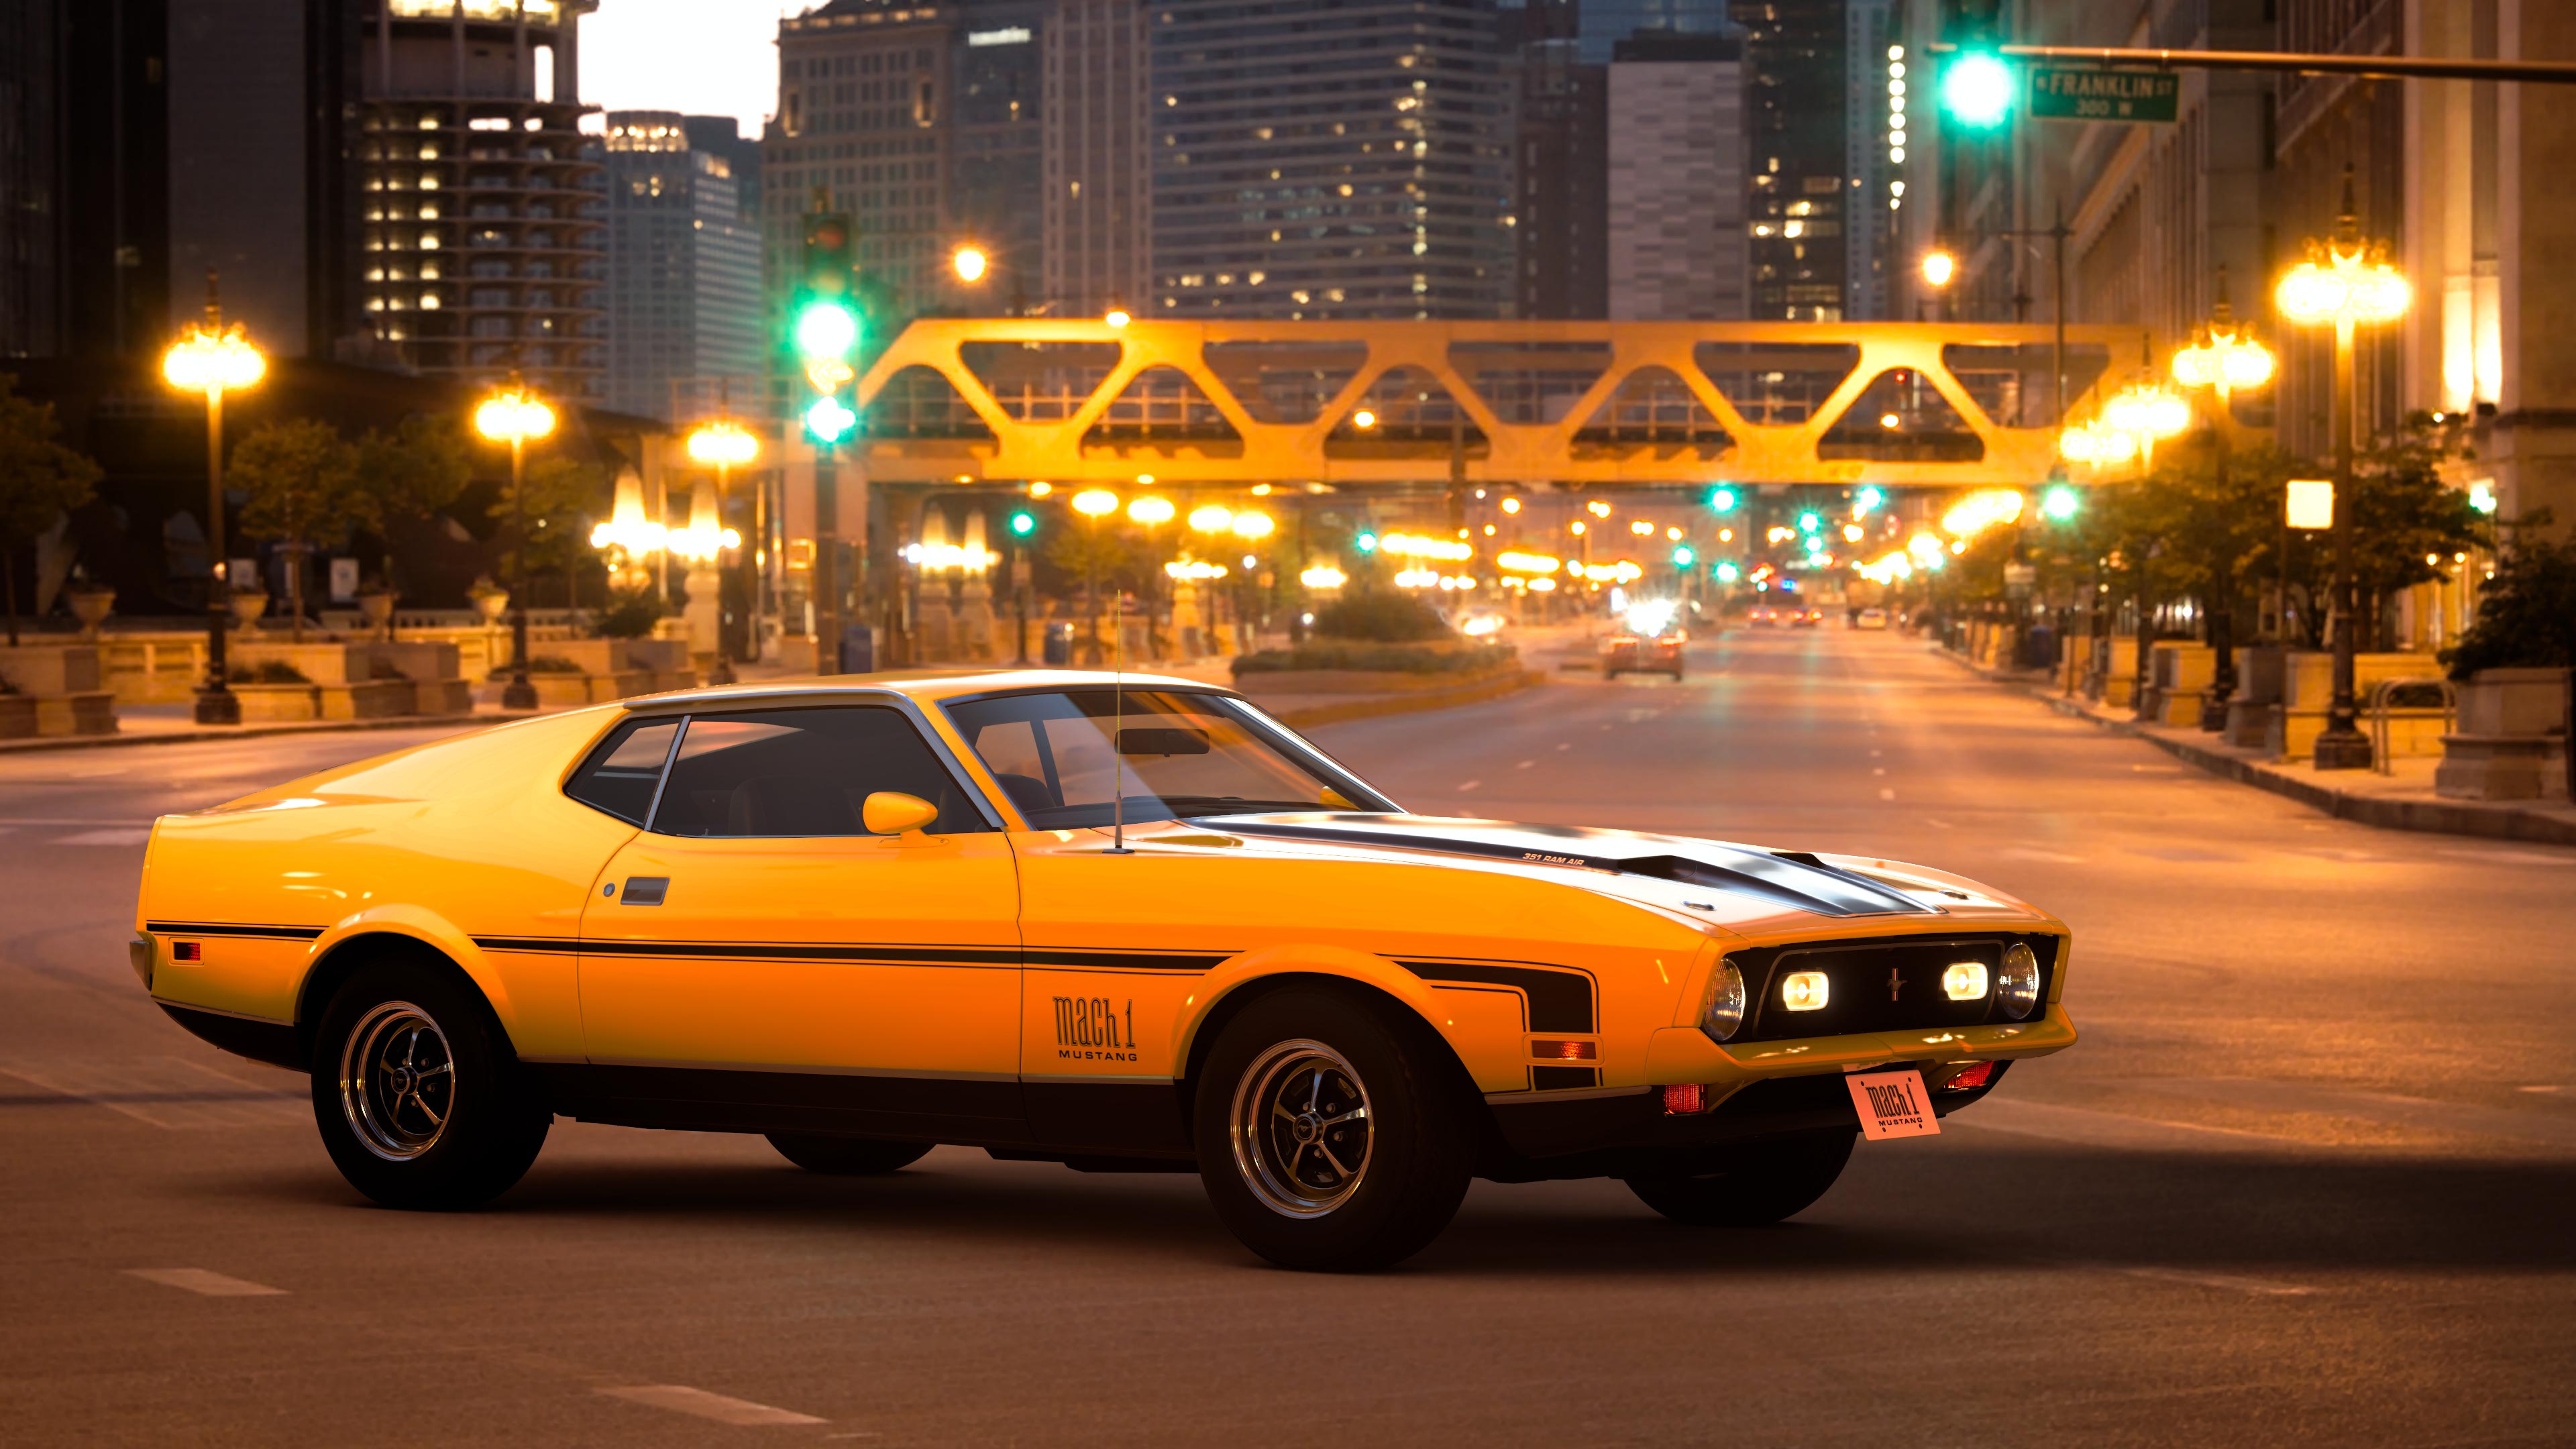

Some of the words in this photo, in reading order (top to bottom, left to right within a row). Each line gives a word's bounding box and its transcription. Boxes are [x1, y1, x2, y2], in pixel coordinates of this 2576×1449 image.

[2049, 72, 2154, 98] FRANKLIN
[2156, 80, 2173, 96] ST
[2076, 99, 2111, 116] 300
[1522, 853, 1542, 861] 351
[1542, 855, 1567, 863] RAM
[1053, 996, 1120, 1049] mach
[1125, 999, 1136, 1049] 1
[1059, 1050, 1137, 1061] MUSTANG
[1865, 1084, 1912, 1118] mach
[1906, 1083, 1920, 1114] 1
[1878, 1117, 1923, 1126] MUSTANG
